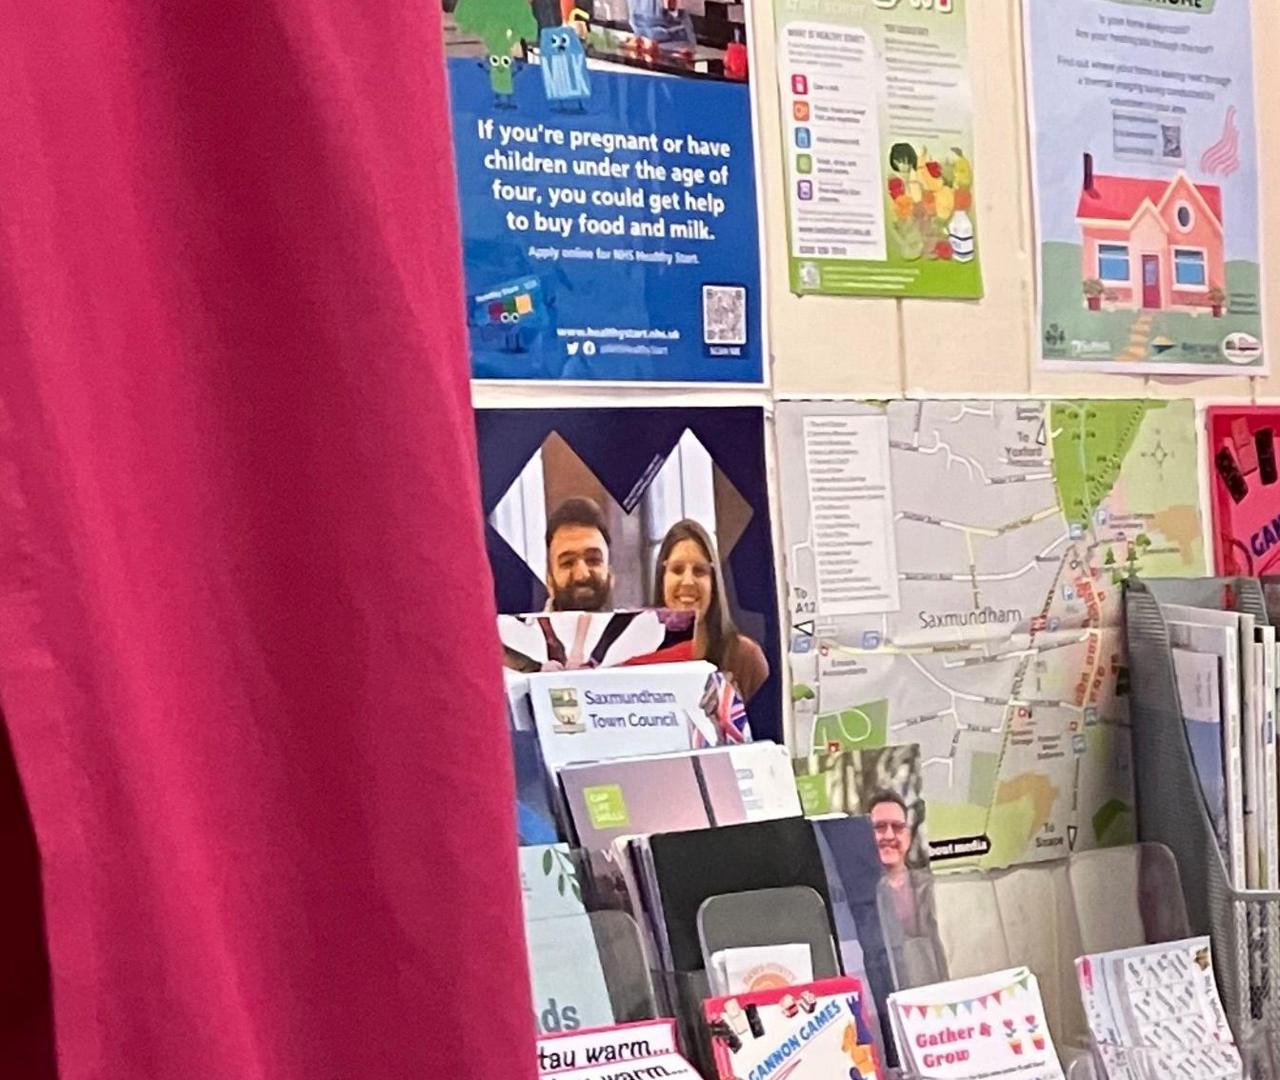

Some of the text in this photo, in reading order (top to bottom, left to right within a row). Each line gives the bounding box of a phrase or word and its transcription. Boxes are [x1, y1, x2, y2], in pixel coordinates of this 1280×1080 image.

[477, 118, 731, 157] If you're pregnant or have
[484, 148, 729, 187] children under the age of
[492, 178, 726, 217] four, you could get help
[506, 210, 716, 240] to buy food and milk.
[528, 246, 559, 260] Apply
[561, 248, 593, 259] online
[613, 249, 634, 261] NHS
[636, 249, 673, 265] Healthy
[794, 587, 807, 598] To
[795, 601, 816, 613] A12
[918, 606, 1022, 629] Saxmundham
[584, 689, 676, 706] Saxmundham
[588, 711, 679, 728] Town Council
[541, 998, 580, 1033] ds
[799, 1000, 842, 1041] GAMES
[915, 1021, 992, 1049] Gather &
[922, 1049, 970, 1069] Grow
